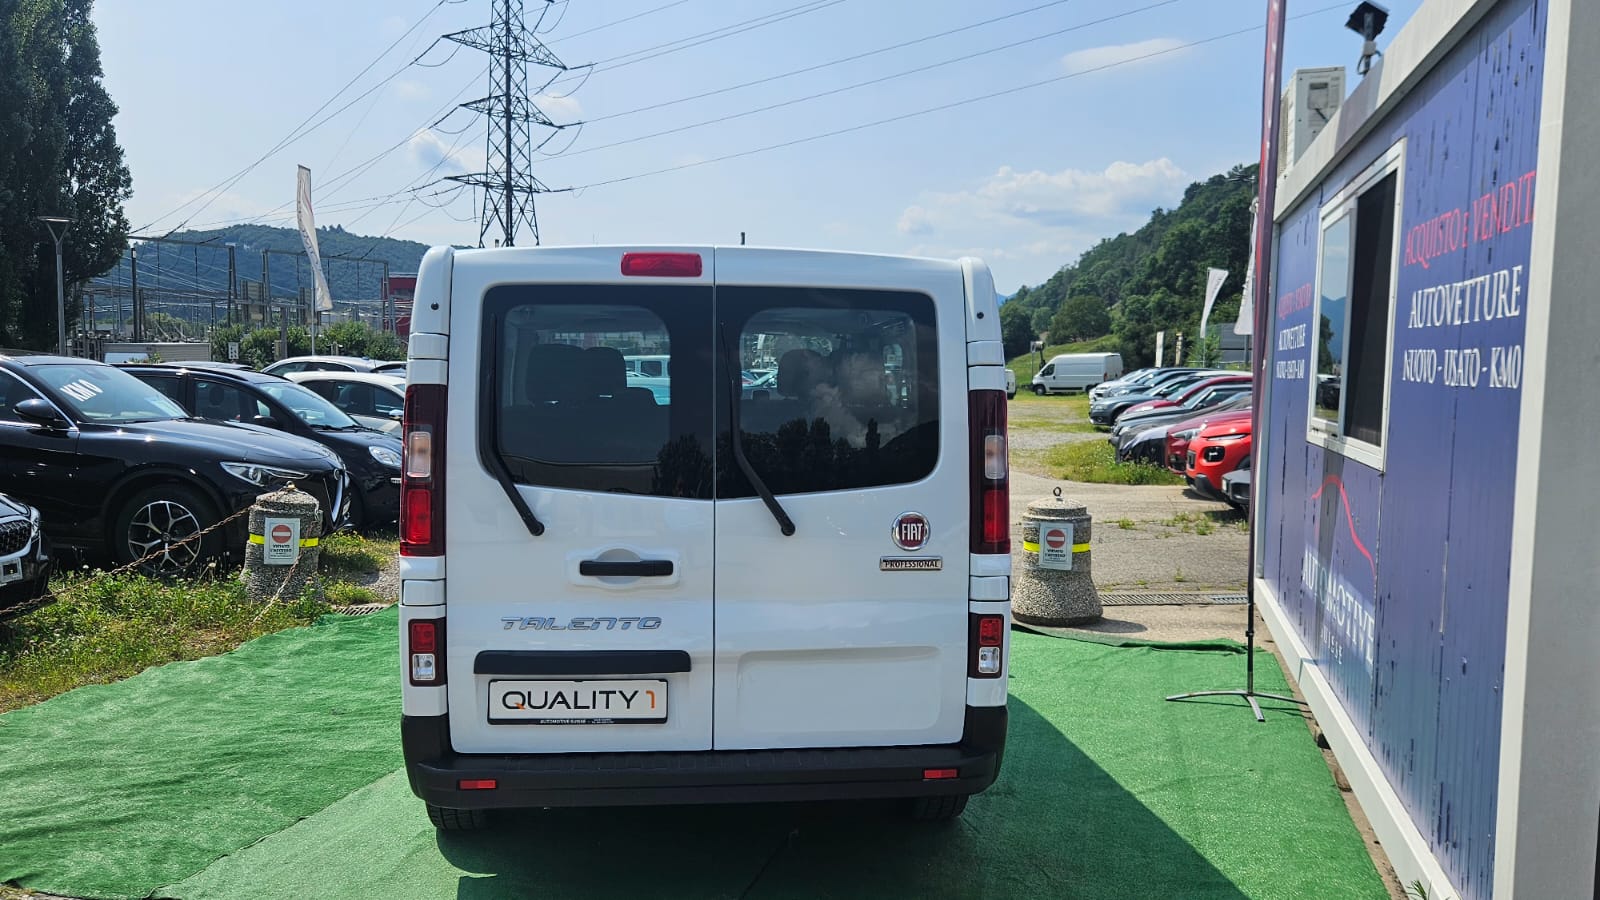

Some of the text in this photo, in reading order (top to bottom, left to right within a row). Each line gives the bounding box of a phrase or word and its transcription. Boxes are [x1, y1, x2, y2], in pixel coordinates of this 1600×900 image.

[1405, 208, 1460, 268] ACQUISTO
[1472, 170, 1536, 243] VENDIT
[1407, 264, 1523, 329] AUTOVETTURE
[1402, 348, 1437, 384] NUOVO
[1443, 348, 1481, 387] USATO
[901, 523, 923, 541] FIAT
[885, 560, 939, 569] PROFESSIONAL
[1302, 547, 1375, 665] AUTOMOTIVE
[501, 616, 662, 631] TALENTO
[502, 690, 639, 710] QUALITY
